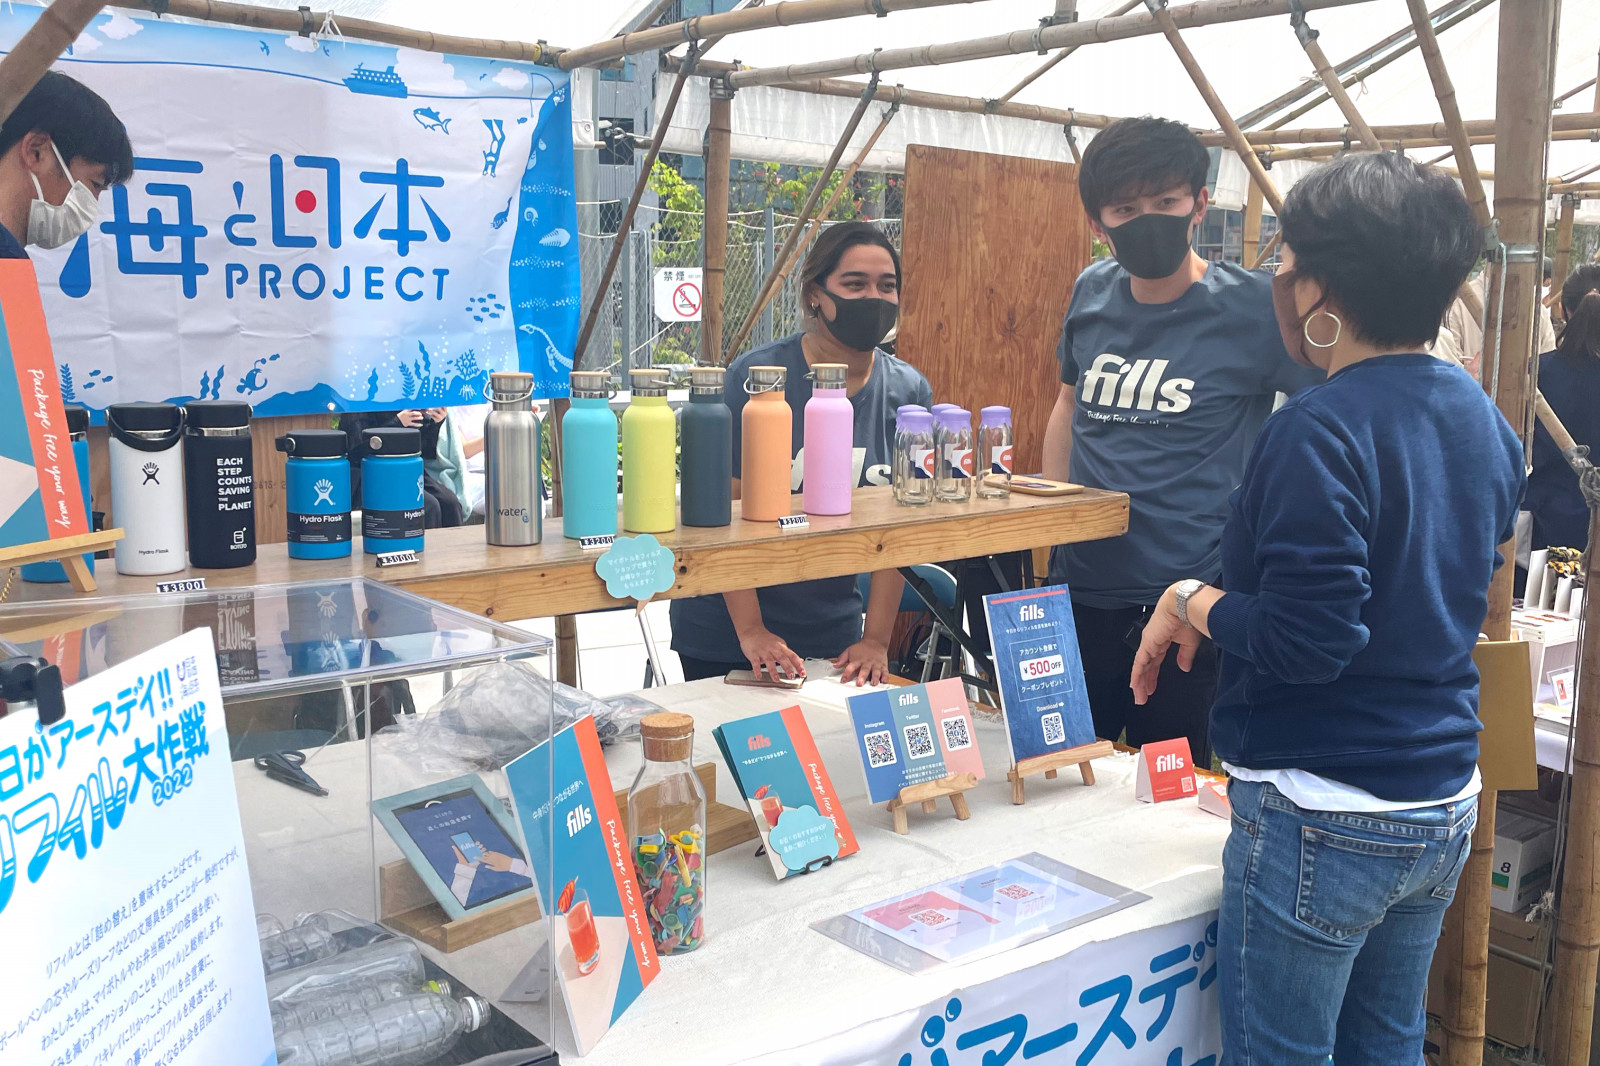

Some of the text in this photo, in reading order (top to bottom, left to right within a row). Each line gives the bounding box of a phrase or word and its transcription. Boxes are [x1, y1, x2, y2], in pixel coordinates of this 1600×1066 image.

[226, 263, 450, 301] PROJECT
[664, 271, 685, 281] 禁煙
[1081, 353, 1195, 413] fills
[27, 369, 51, 430] Package
[217, 458, 243, 466] EACH
[217, 468, 242, 476] STEP
[218, 476, 252, 486] COUNTS
[218, 486, 250, 495] SAVING
[218, 501, 252, 511] PLANET
[496, 507, 526, 517] water
[299, 514, 342, 524] Hydro Flask
[162, 581, 200, 593] ¥3800
[1019, 604, 1045, 622] fills
[1029, 660, 1051, 676] 500
[1051, 661, 1062, 670] OFF
[898, 693, 919, 707] fills
[1036, 702, 1058, 712] Download
[748, 734, 771, 751] fills
[1156, 753, 1184, 773] fills
[152, 763, 194, 807] 2022
[566, 803, 592, 838] fills
[606, 819, 627, 876] Package
[1501, 862, 1511, 873] 8
